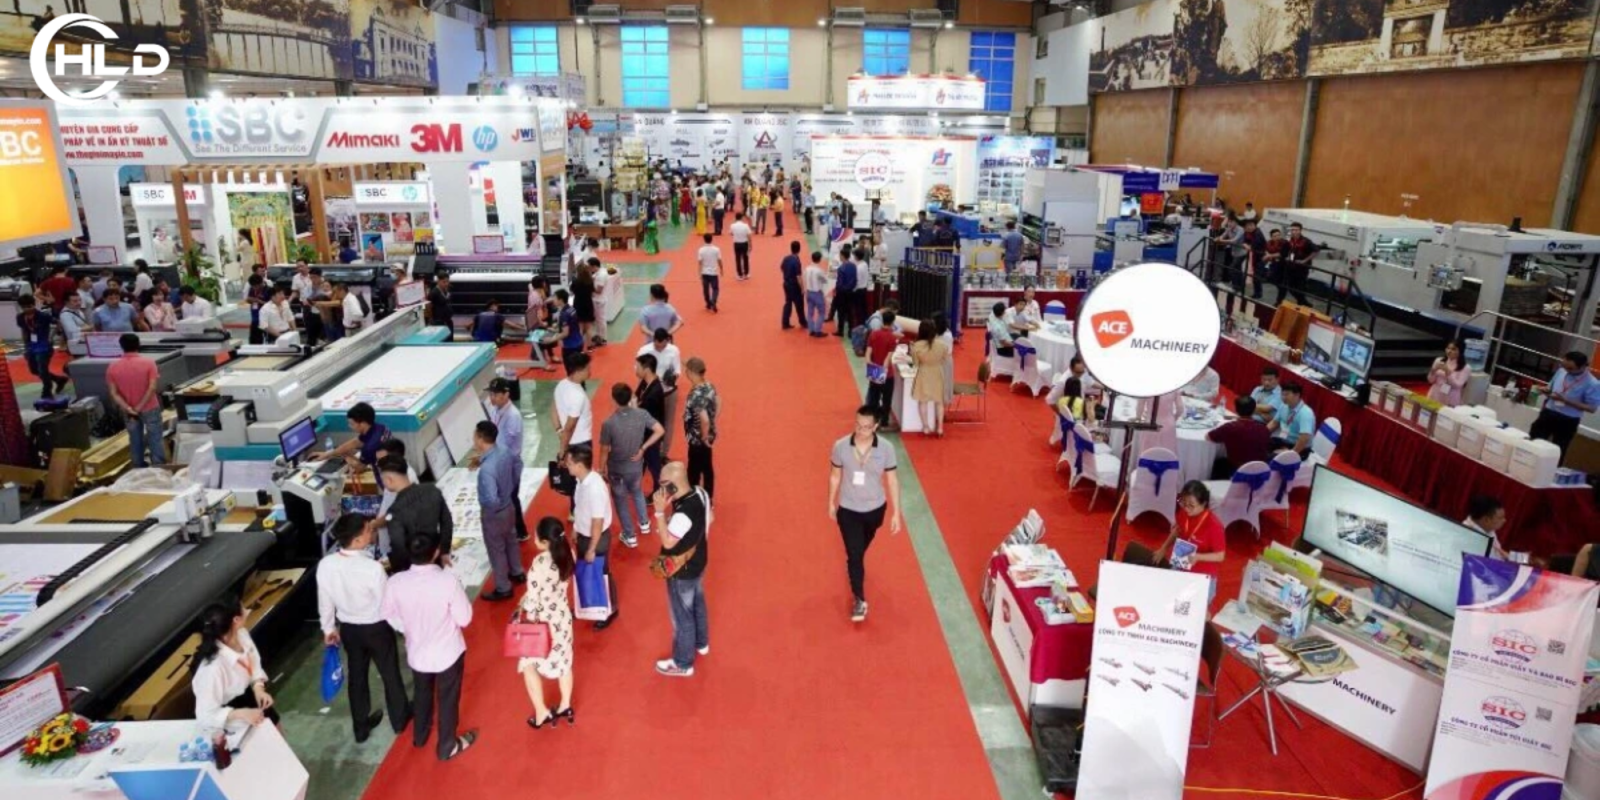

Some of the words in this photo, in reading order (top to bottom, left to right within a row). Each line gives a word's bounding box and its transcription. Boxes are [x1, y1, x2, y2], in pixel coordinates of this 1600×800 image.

[215, 106, 305, 143] SBC
[410, 123, 463, 153] 3M
[859, 166, 888, 175] SIC
[144, 189, 165, 199] SBC
[365, 187, 387, 197] SBC
[1098, 321, 1128, 334] ACE
[1130, 337, 1210, 354] MACHINERY
[1138, 623, 1187, 637] MACHINERY
[1491, 636, 1537, 654] SIC
[1332, 678, 1396, 715] MACHINERY
[1481, 703, 1526, 721] SIC
